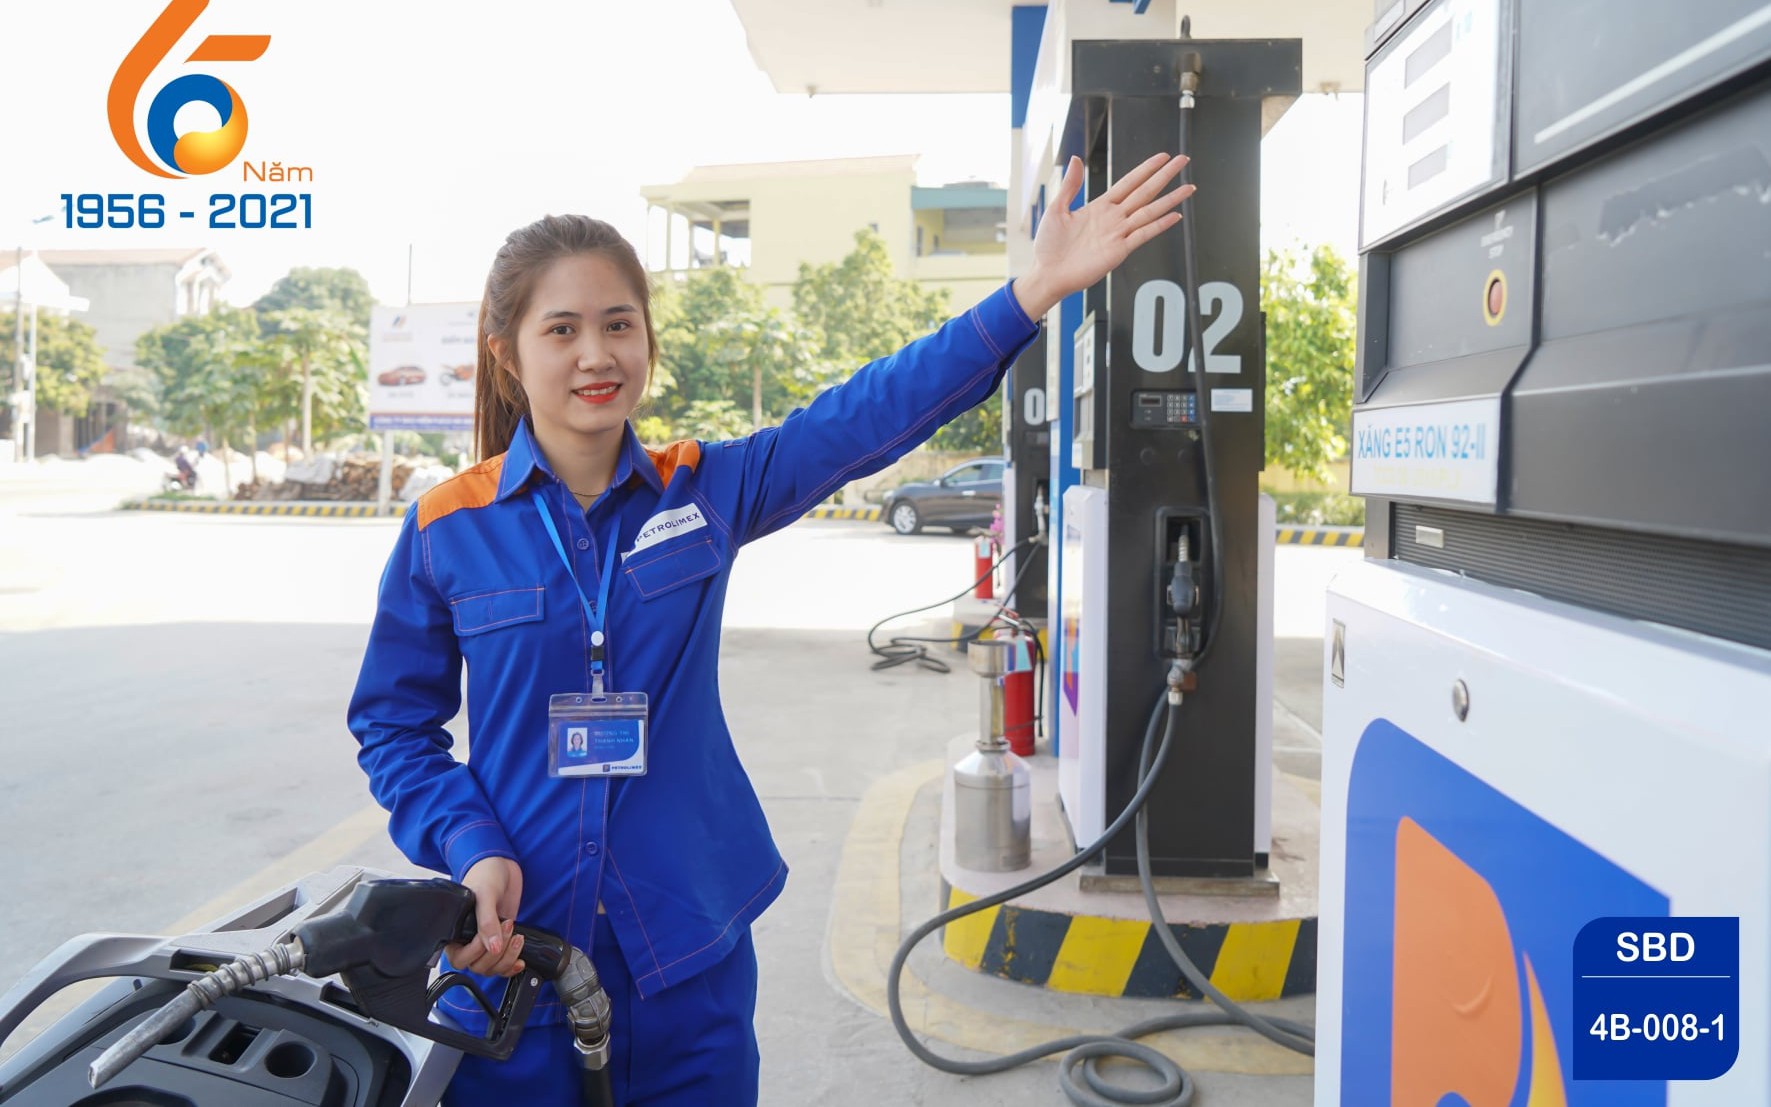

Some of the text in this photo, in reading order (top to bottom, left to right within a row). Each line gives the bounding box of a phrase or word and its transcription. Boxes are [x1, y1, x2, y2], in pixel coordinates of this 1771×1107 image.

[1132, 279, 1244, 374] 02
[1024, 388, 1045, 425] 0
[1358, 424, 1485, 460] XĂNG E5 RON 92-II
